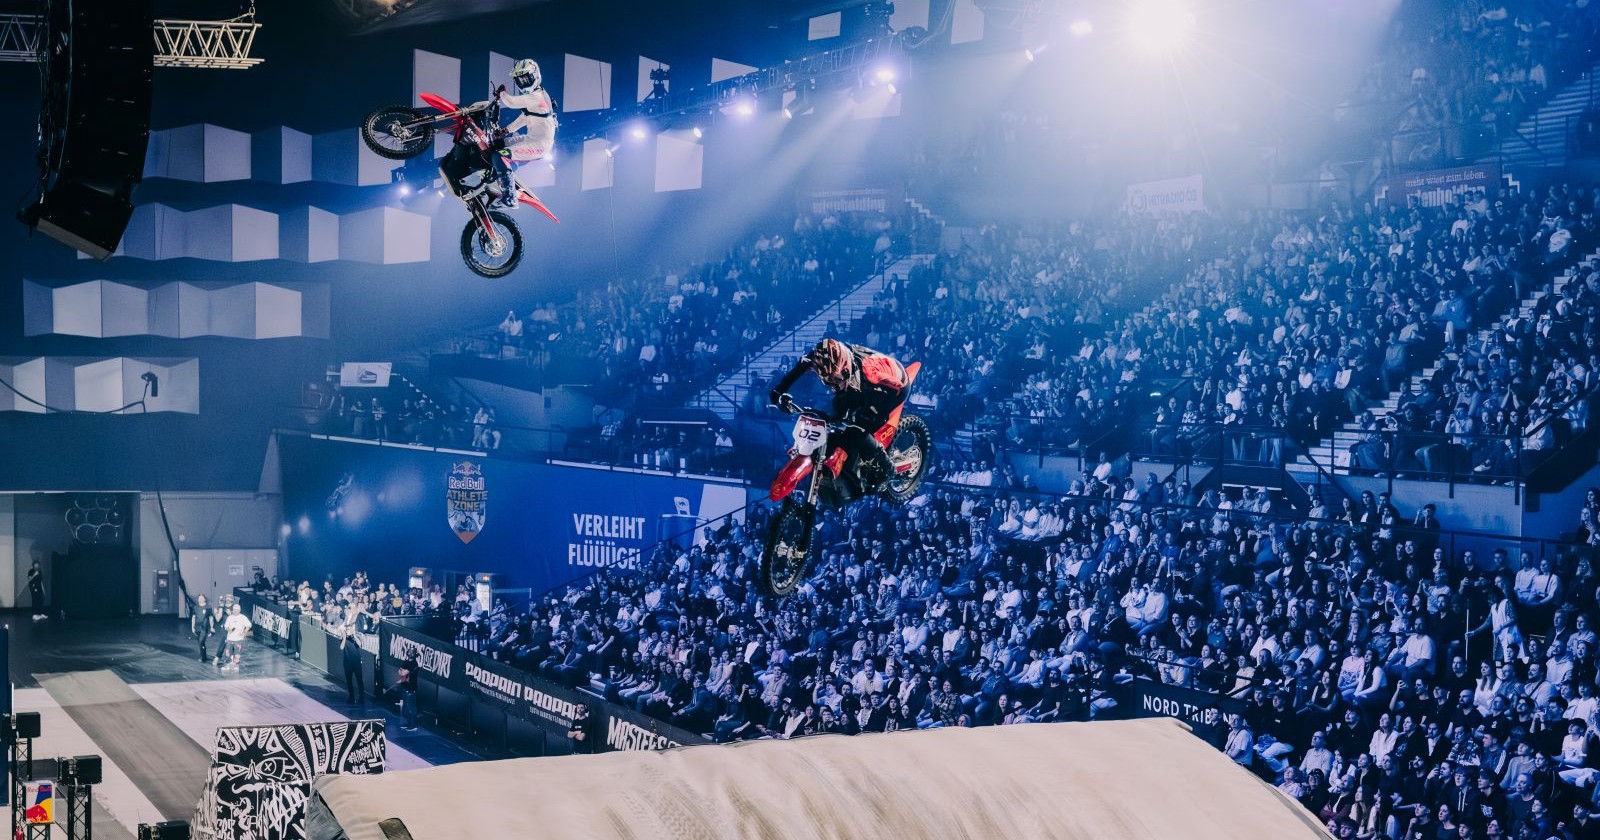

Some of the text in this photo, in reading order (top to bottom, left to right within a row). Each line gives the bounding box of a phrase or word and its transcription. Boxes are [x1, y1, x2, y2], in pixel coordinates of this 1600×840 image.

[799, 428, 821, 442] 02
[446, 490, 488, 501] ATHLETE
[453, 501, 480, 512] ZONE
[573, 513, 645, 539] VERLEIHT
[431, 650, 454, 679] DIRT
[524, 686, 577, 721] PROPAI
[1143, 694, 1235, 725] NORD TRIBN
